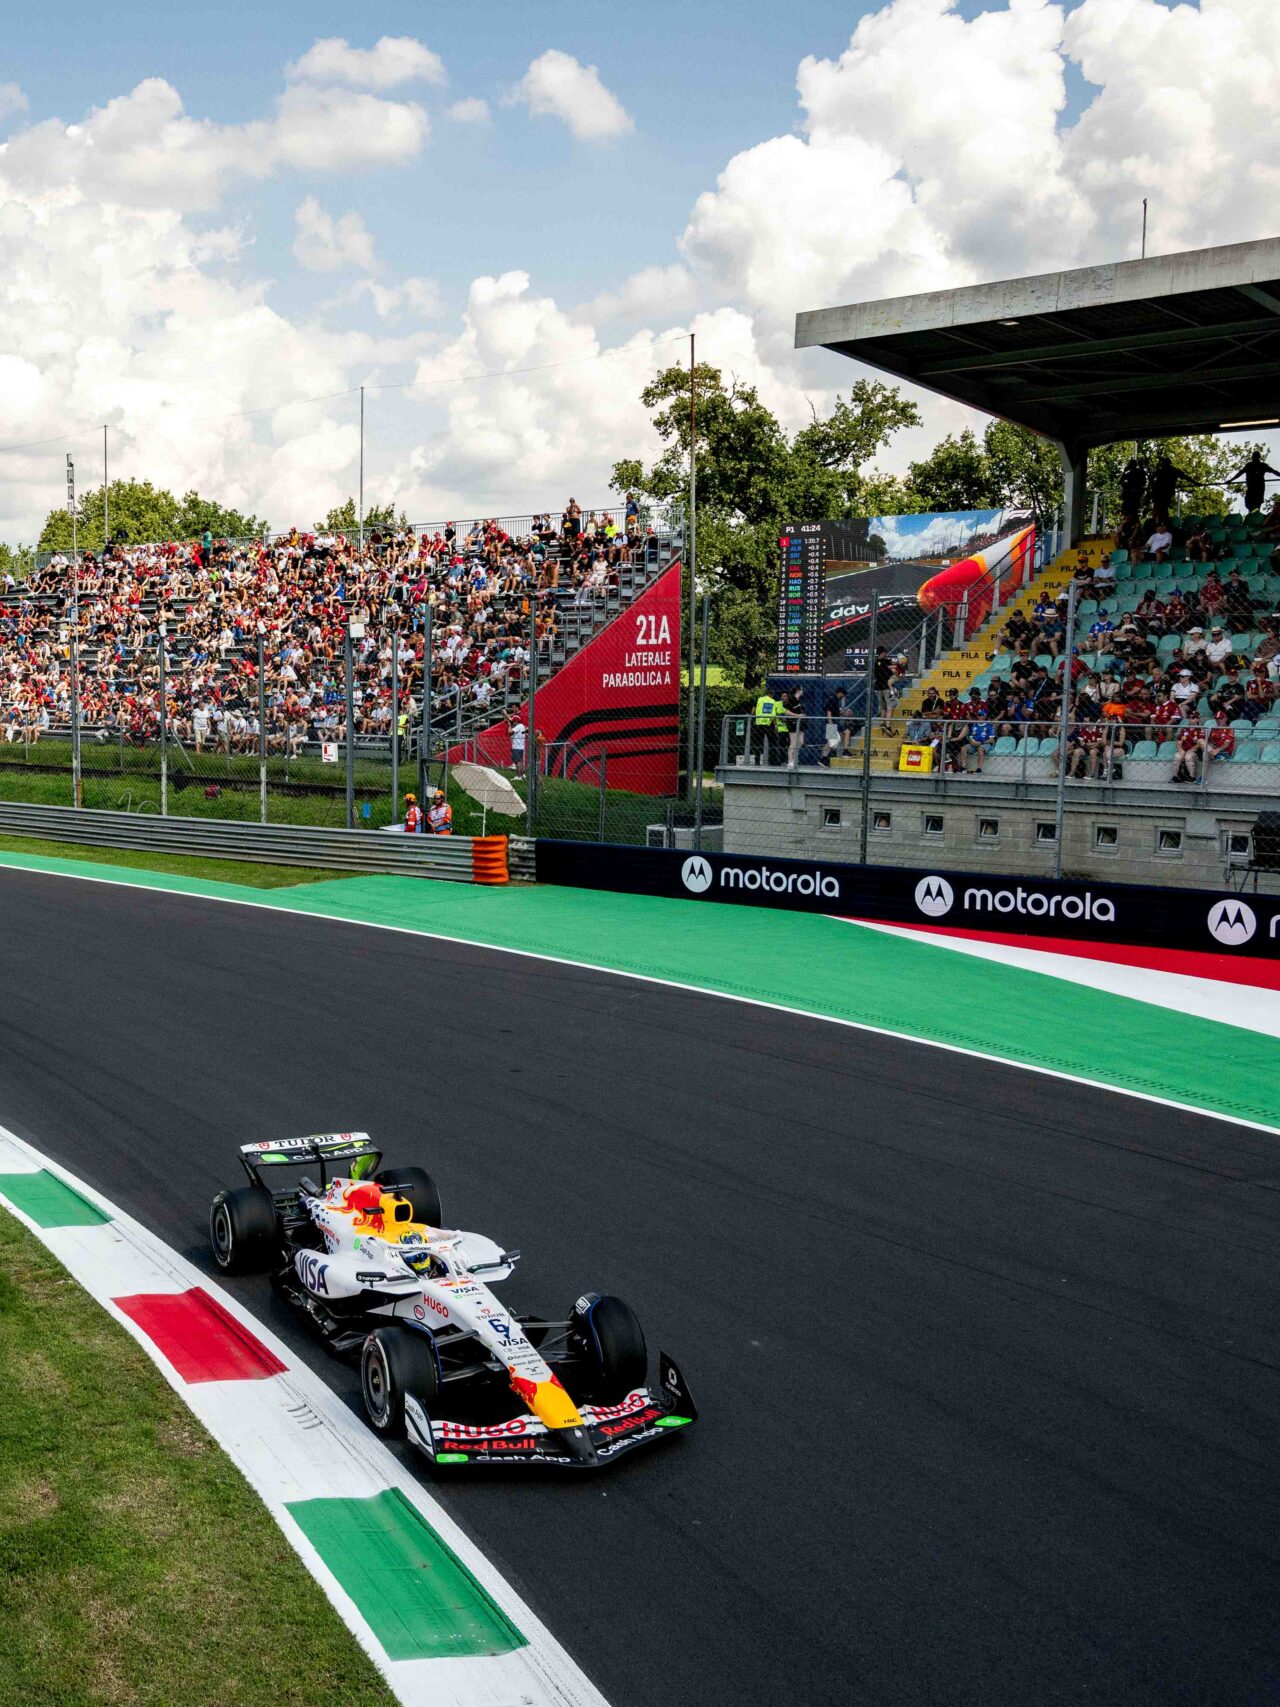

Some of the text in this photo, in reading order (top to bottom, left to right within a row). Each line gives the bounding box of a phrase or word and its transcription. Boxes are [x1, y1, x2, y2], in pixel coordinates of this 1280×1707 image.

[636, 614, 671, 645] 21A
[625, 651, 671, 667] LATERALE
[602, 671, 671, 688] PARABOLICA A
[721, 866, 840, 897] motorola
[964, 888, 1115, 922] motorola
[333, 1147, 363, 1156] App
[299, 1252, 329, 1295] VISA
[450, 1286, 479, 1294] VISA
[423, 1294, 449, 1318] HUGO
[475, 1312, 506, 1320] TUDOR
[497, 1337, 528, 1347] VISA
[442, 1419, 527, 1438] HUGO
[599, 1417, 633, 1436] Red
[444, 1439, 535, 1449] Red Bull
[596, 1427, 664, 1456] Cash App
[530, 1454, 571, 1463] App
